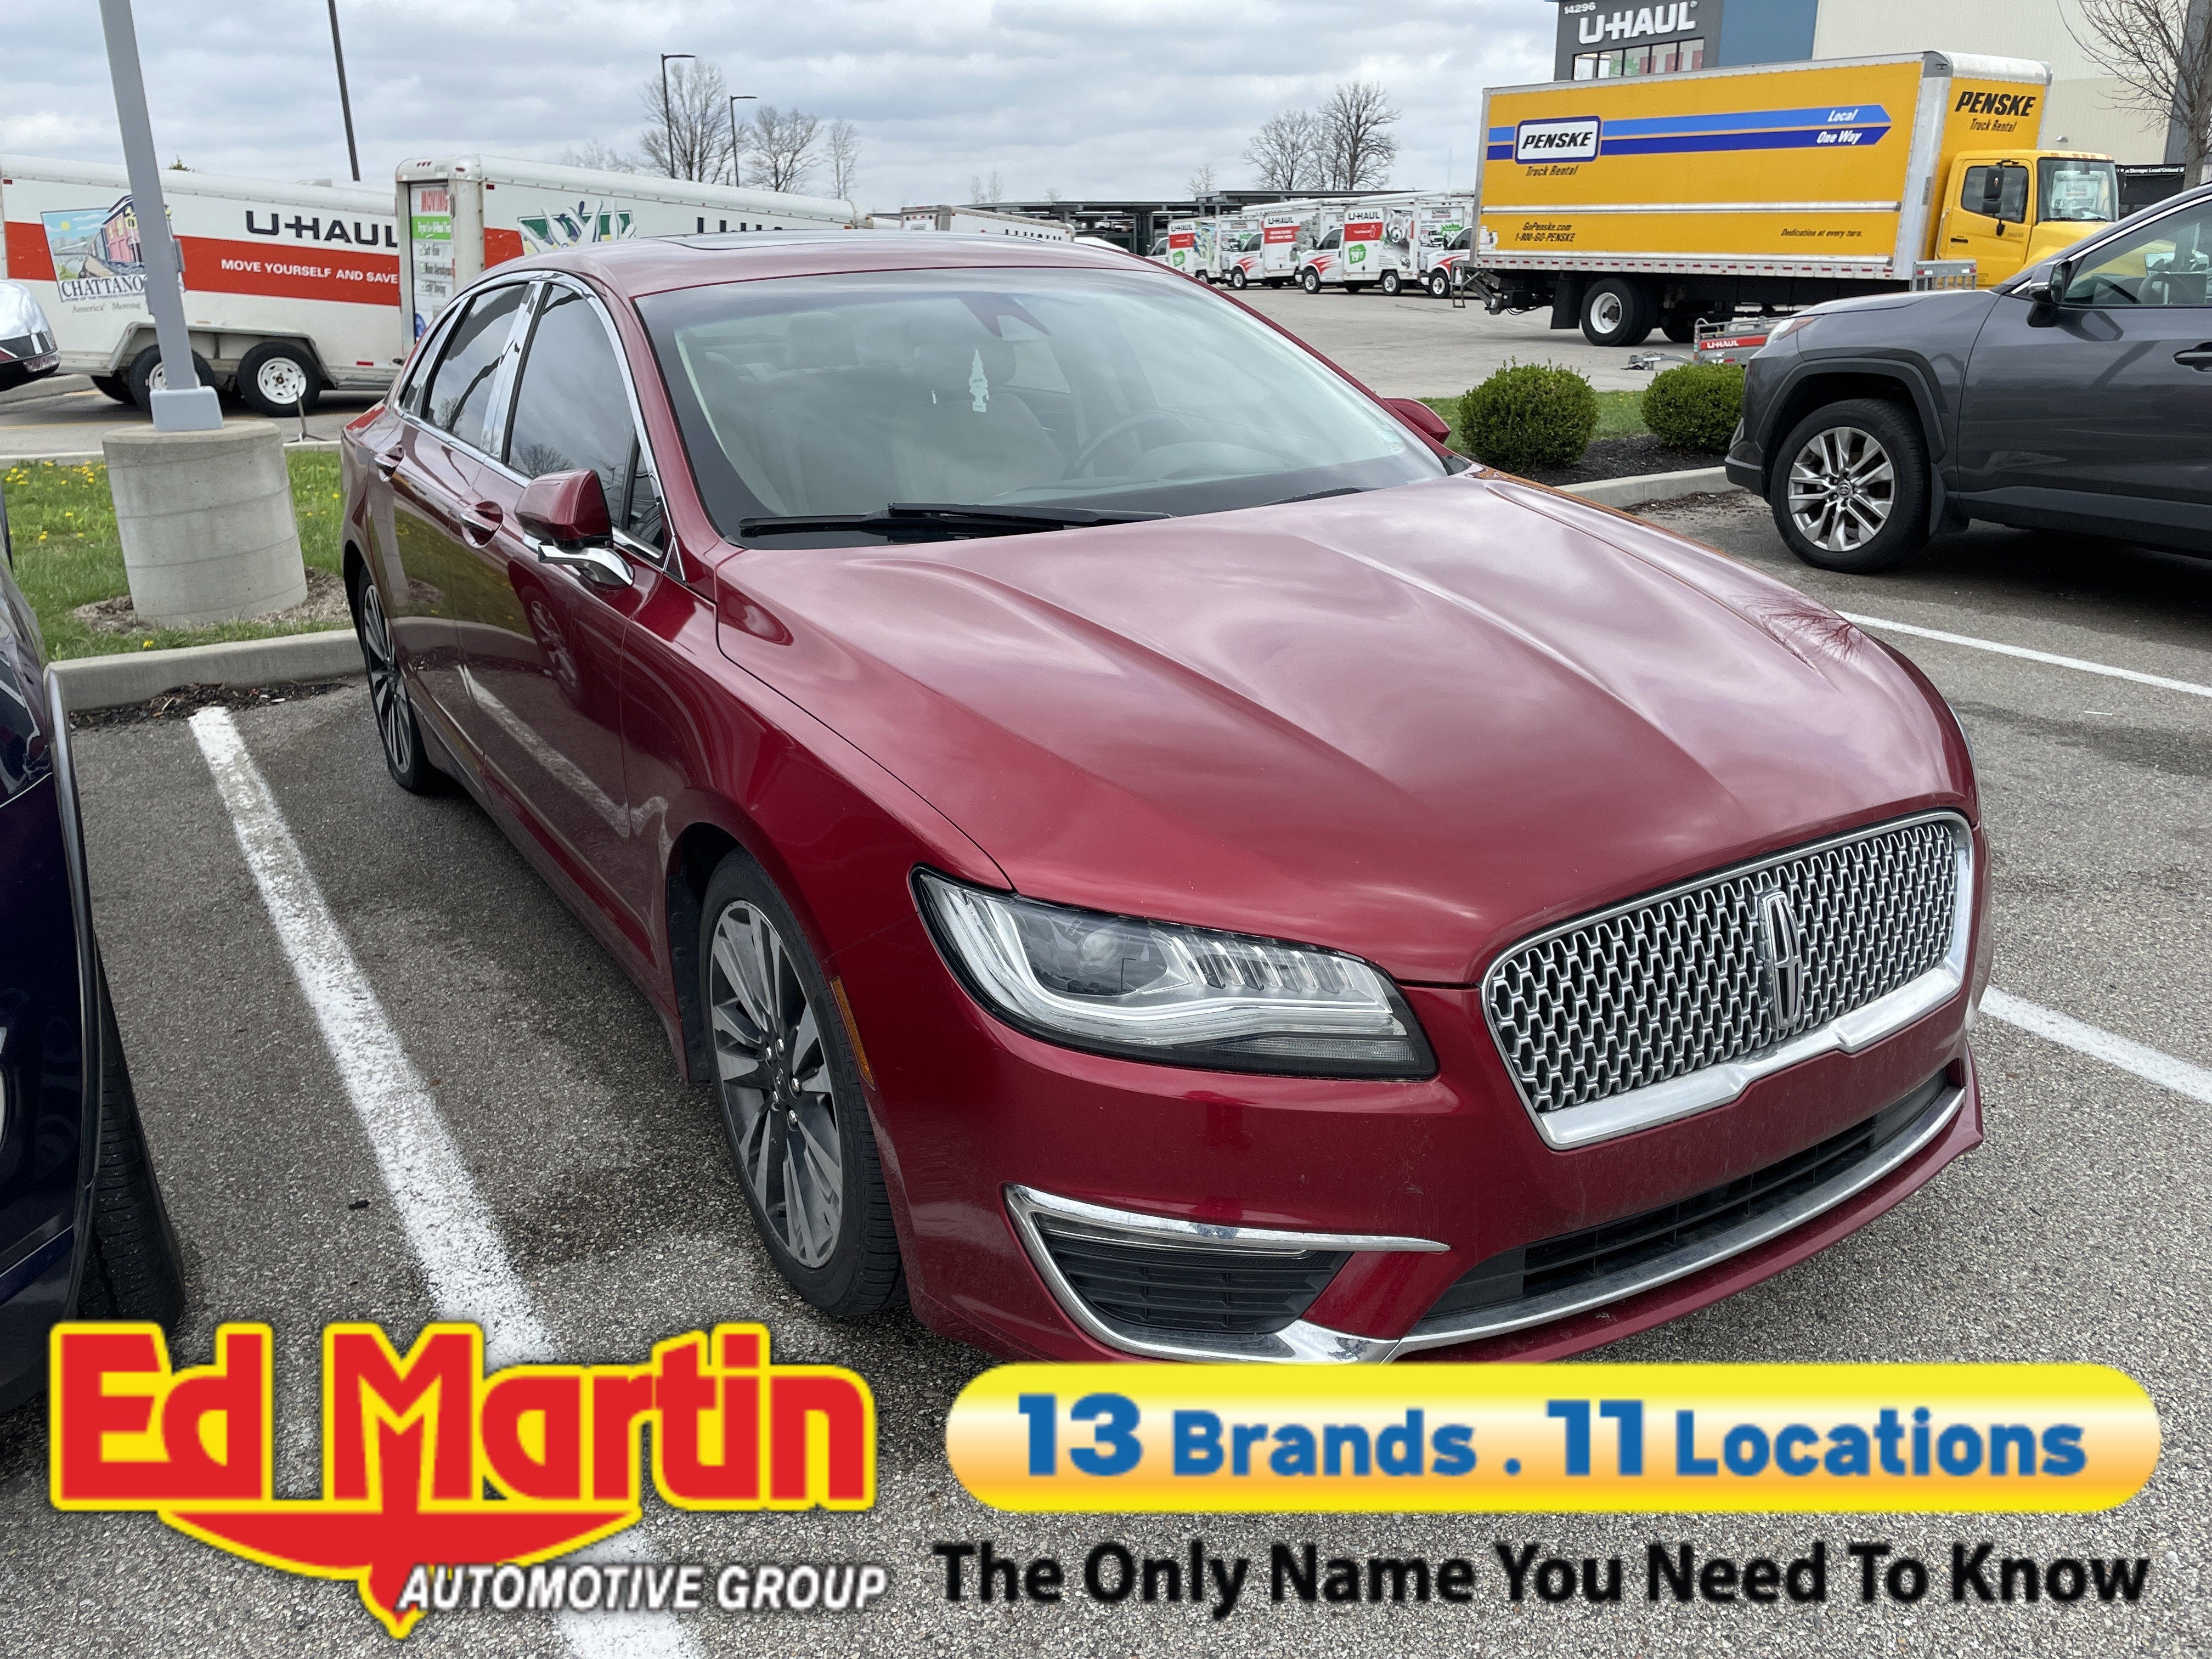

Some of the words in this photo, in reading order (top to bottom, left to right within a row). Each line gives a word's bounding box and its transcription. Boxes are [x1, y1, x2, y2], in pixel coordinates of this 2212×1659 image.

[1564, 2, 1596, 15] 14296
[1578, 2, 1696, 45] U-HAUL
[1954, 91, 2036, 117] PENSKE
[1827, 108, 1859, 122] Local
[1970, 118, 1991, 130] Truck
[1991, 119, 2017, 132] Rental
[1522, 132, 1593, 149] PENSKE
[1816, 131, 1838, 144] One
[1837, 130, 1863, 145] Way
[1526, 165, 1549, 177] Truck
[1549, 164, 1579, 176] Rental
[1348, 212, 1380, 220] U-HAUL
[245, 210, 398, 247] U-HAUL
[1522, 222, 1572, 230] GoPenske.com
[1515, 232, 1576, 241] 1-800-GO-PENSKE
[221, 258, 261, 273] MOVE
[264, 262, 332, 278] YOURSELF
[336, 269, 364, 281] AND
[366, 272, 398, 284] SAVE
[1707, 340, 1739, 349] U-HAUL
